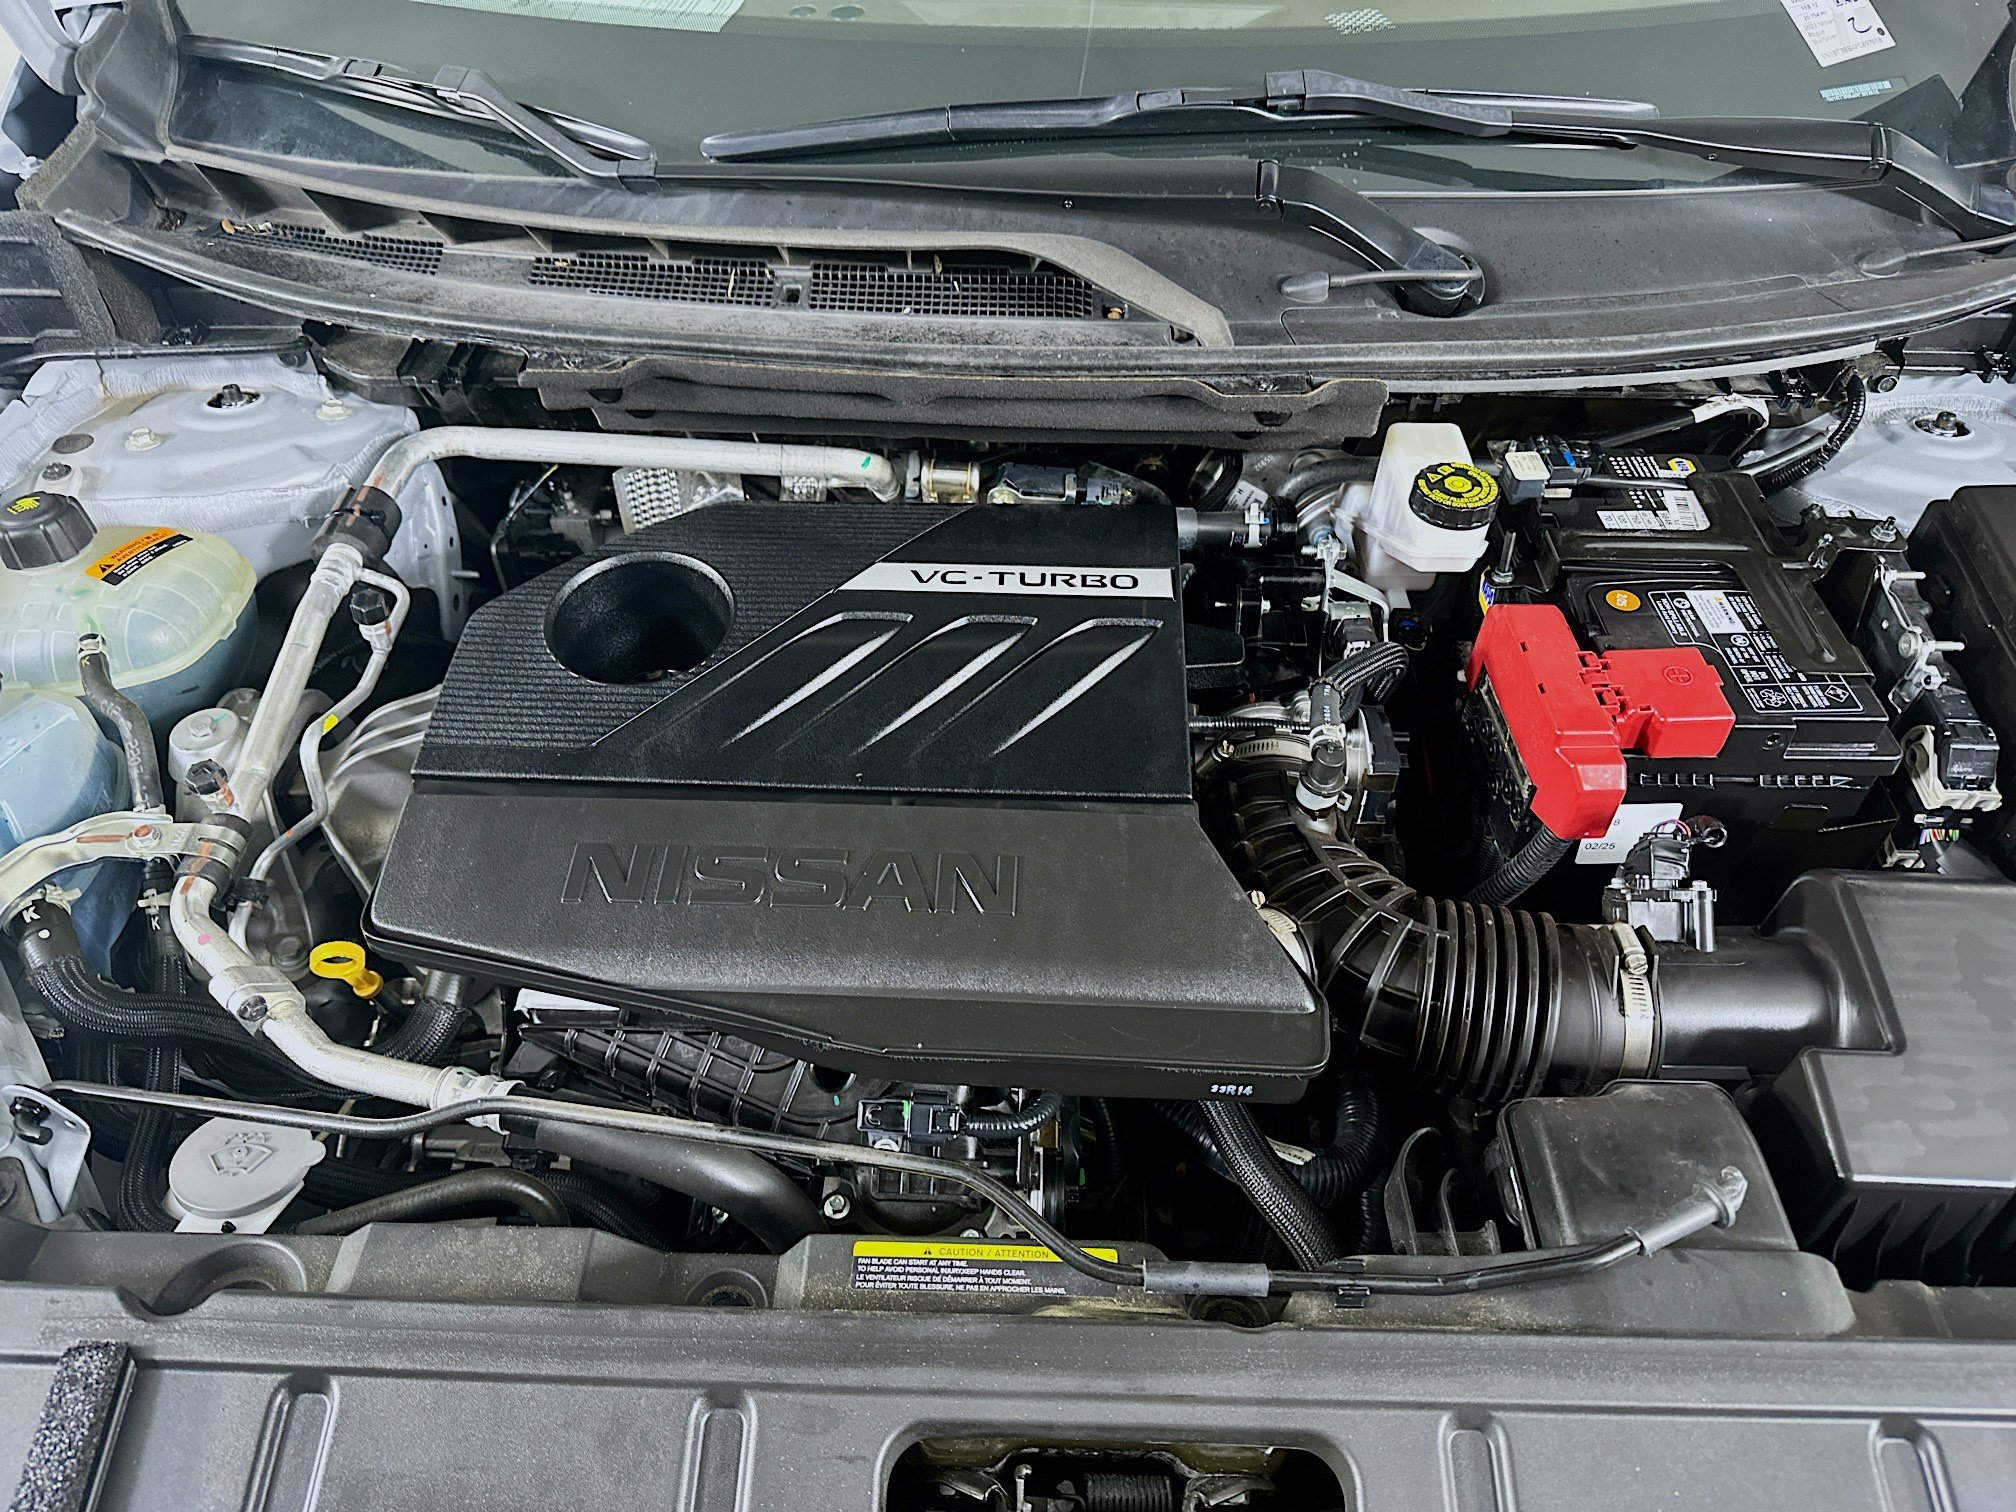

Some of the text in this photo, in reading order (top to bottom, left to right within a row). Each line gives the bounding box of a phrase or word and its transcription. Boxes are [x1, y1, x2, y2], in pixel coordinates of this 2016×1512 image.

[911, 570, 1138, 590] VC-TURBO
[81, 656, 90, 667] K
[1584, 842, 1616, 850] 02/25
[561, 843, 1018, 916] NISSAN
[22, 906, 41, 924] K
[151, 916, 160, 930] K
[939, 1247, 984, 1256] CAUTION
[994, 1249, 1049, 1258] ATTENTION
